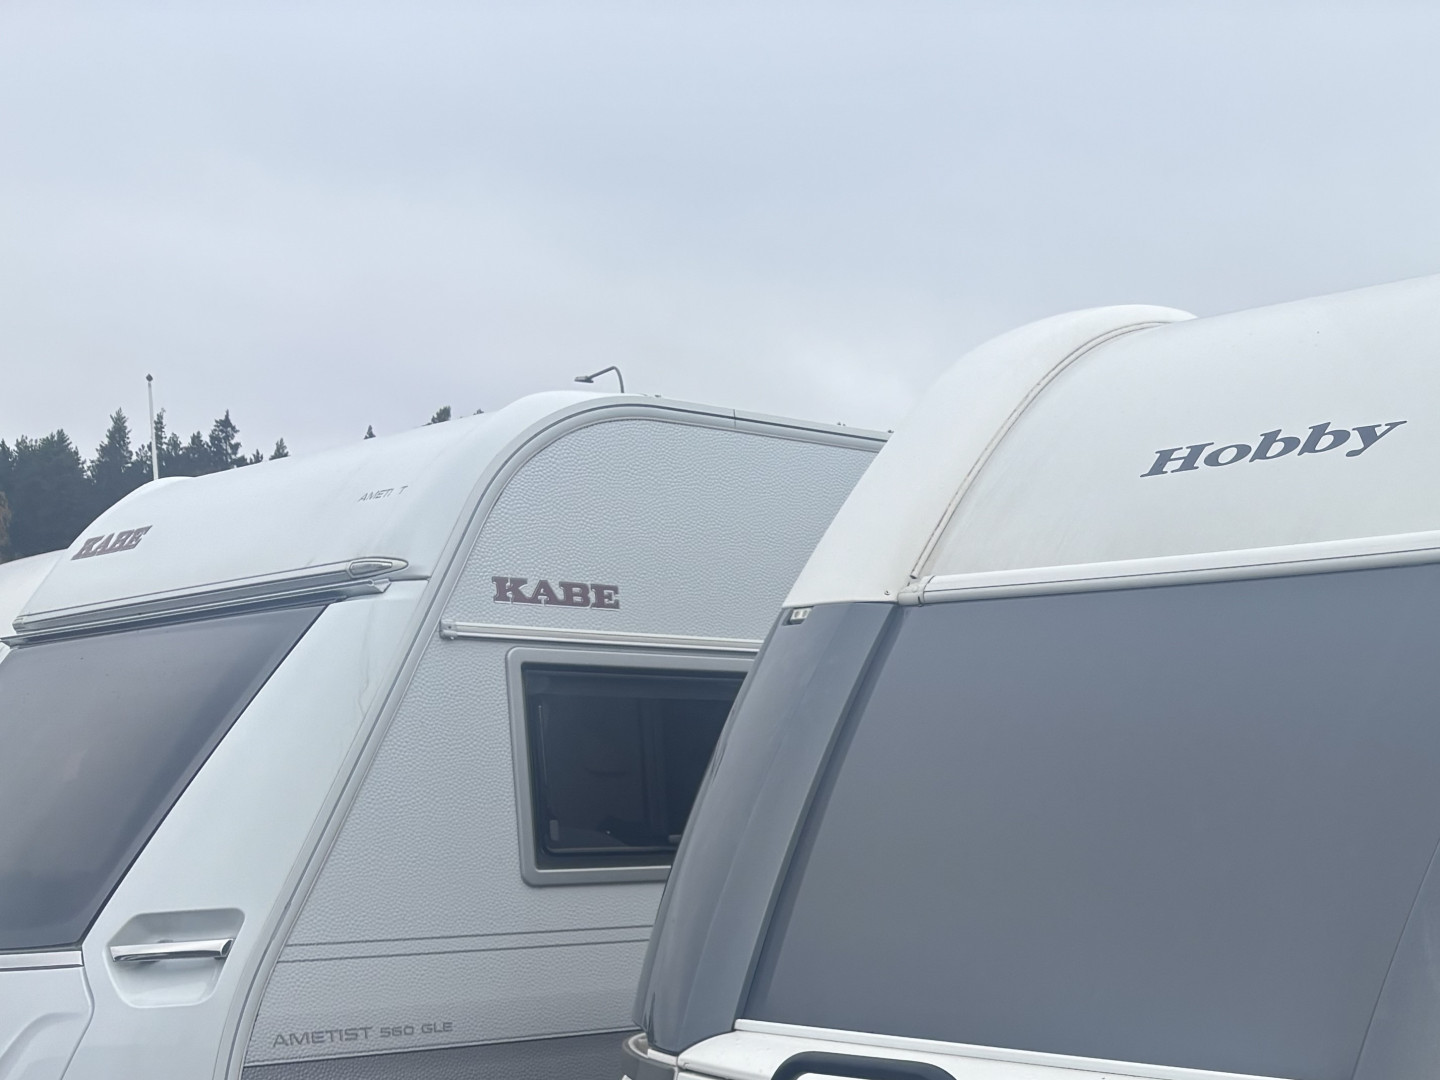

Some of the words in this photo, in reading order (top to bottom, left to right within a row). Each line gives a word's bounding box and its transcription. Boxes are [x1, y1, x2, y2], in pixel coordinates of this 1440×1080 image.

[1140, 420, 1408, 478] Hobby
[358, 485, 408, 502] AMETIT
[70, 525, 153, 561] KABE
[491, 576, 620, 610] KABE
[272, 1026, 374, 1048] AMETIST
[379, 1026, 415, 1039] 560
[421, 1021, 453, 1035] GLE
